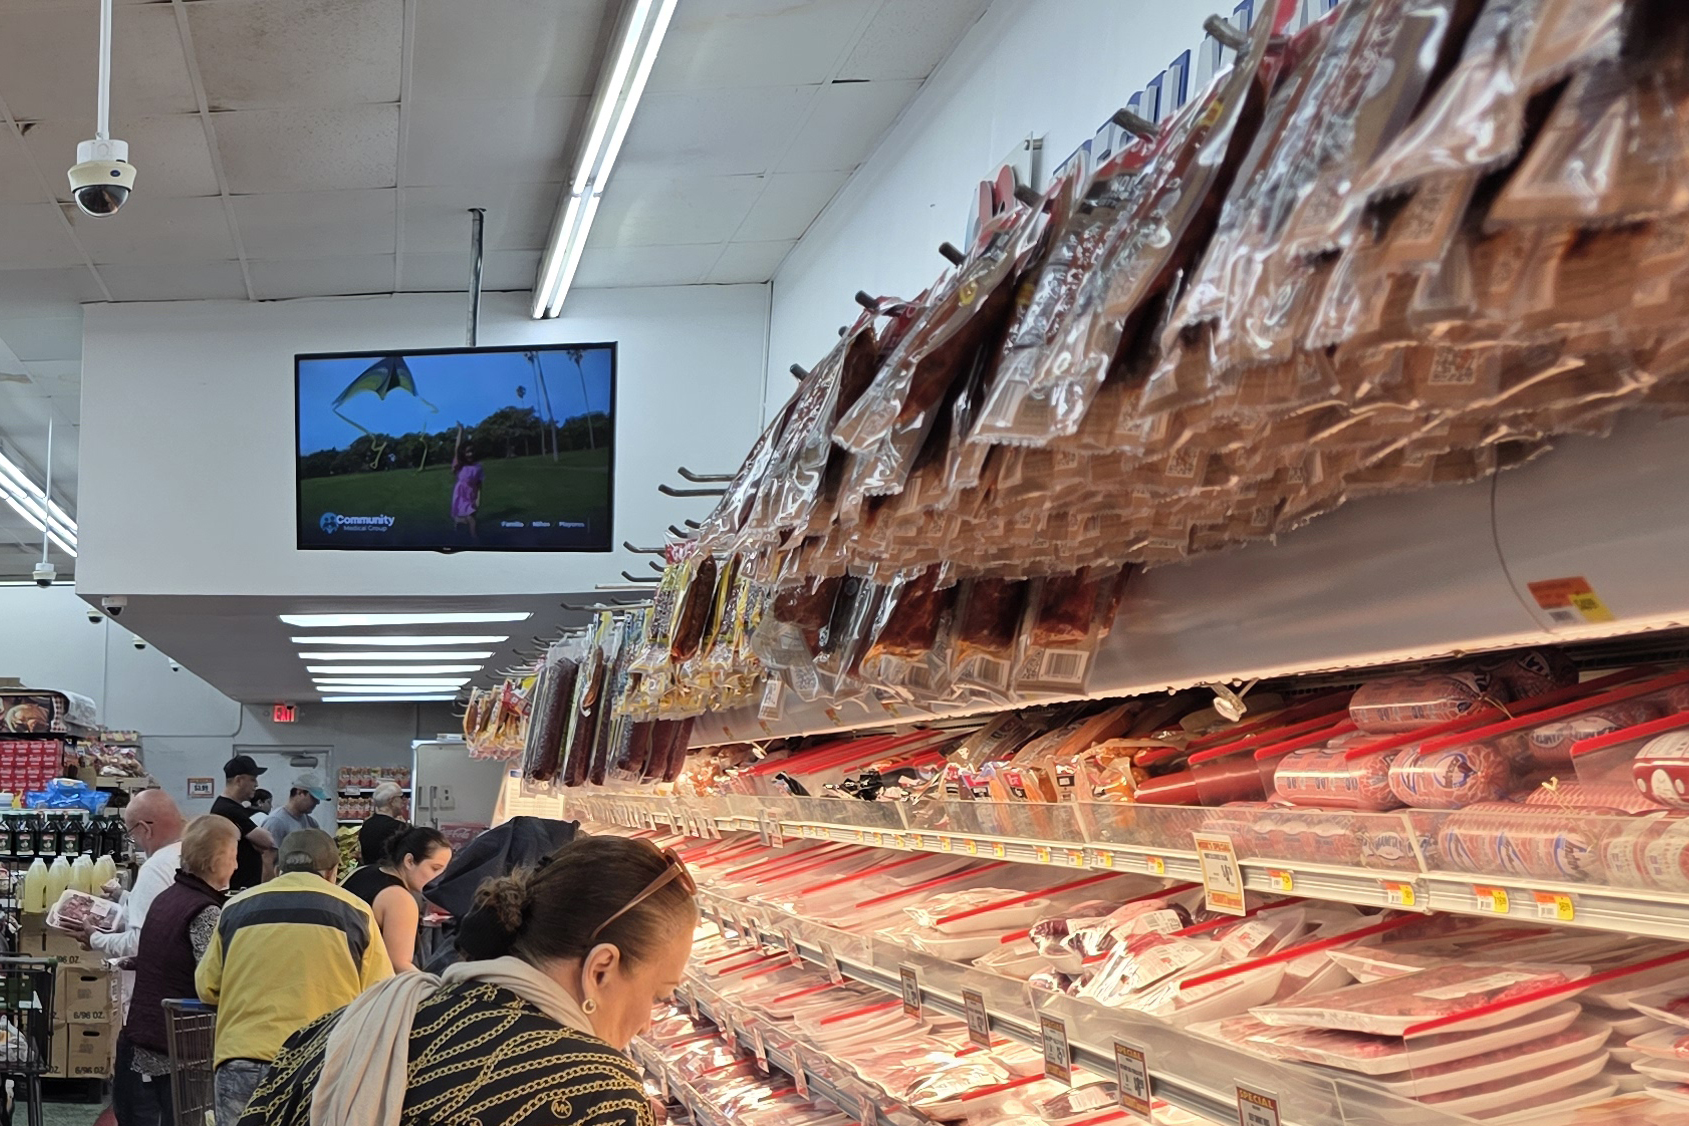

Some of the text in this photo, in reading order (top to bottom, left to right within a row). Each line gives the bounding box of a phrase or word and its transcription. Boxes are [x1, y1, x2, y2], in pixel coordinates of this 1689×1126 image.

[336, 514, 395, 527] Community
[275, 706, 294, 720] EXIT
[1240, 1090, 1274, 1109] SPECIAL
